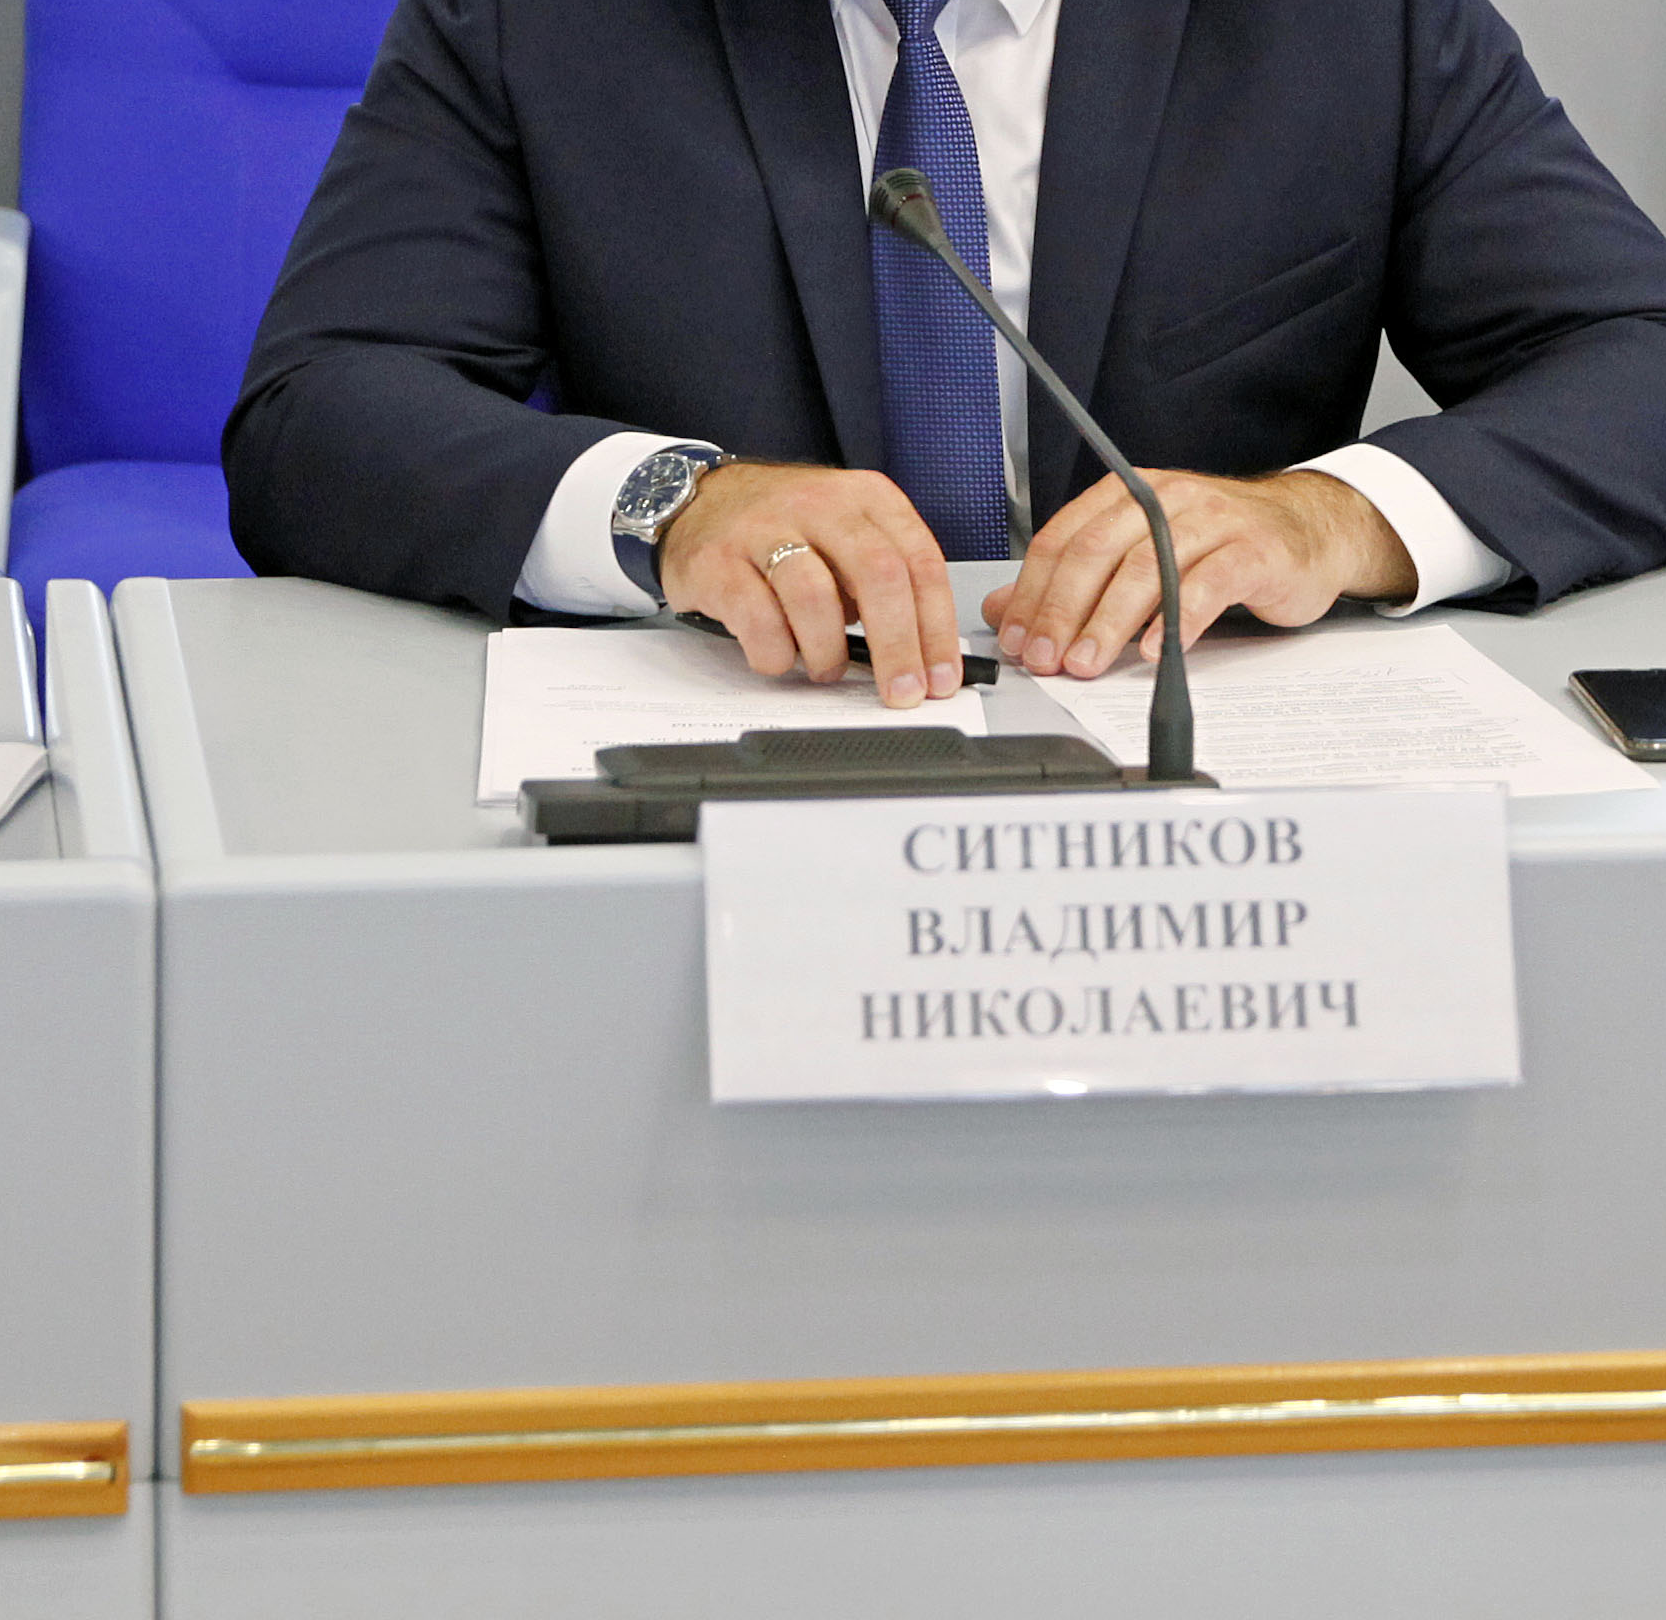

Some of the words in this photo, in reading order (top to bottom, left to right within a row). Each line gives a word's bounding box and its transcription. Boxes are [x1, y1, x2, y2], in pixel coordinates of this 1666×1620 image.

[903, 817, 1304, 874] СИТНИКОВ
[905, 899, 1309, 962] ВЛАДИМИР
[859, 980, 1361, 1041] НИКОЛАЕВИЧ
